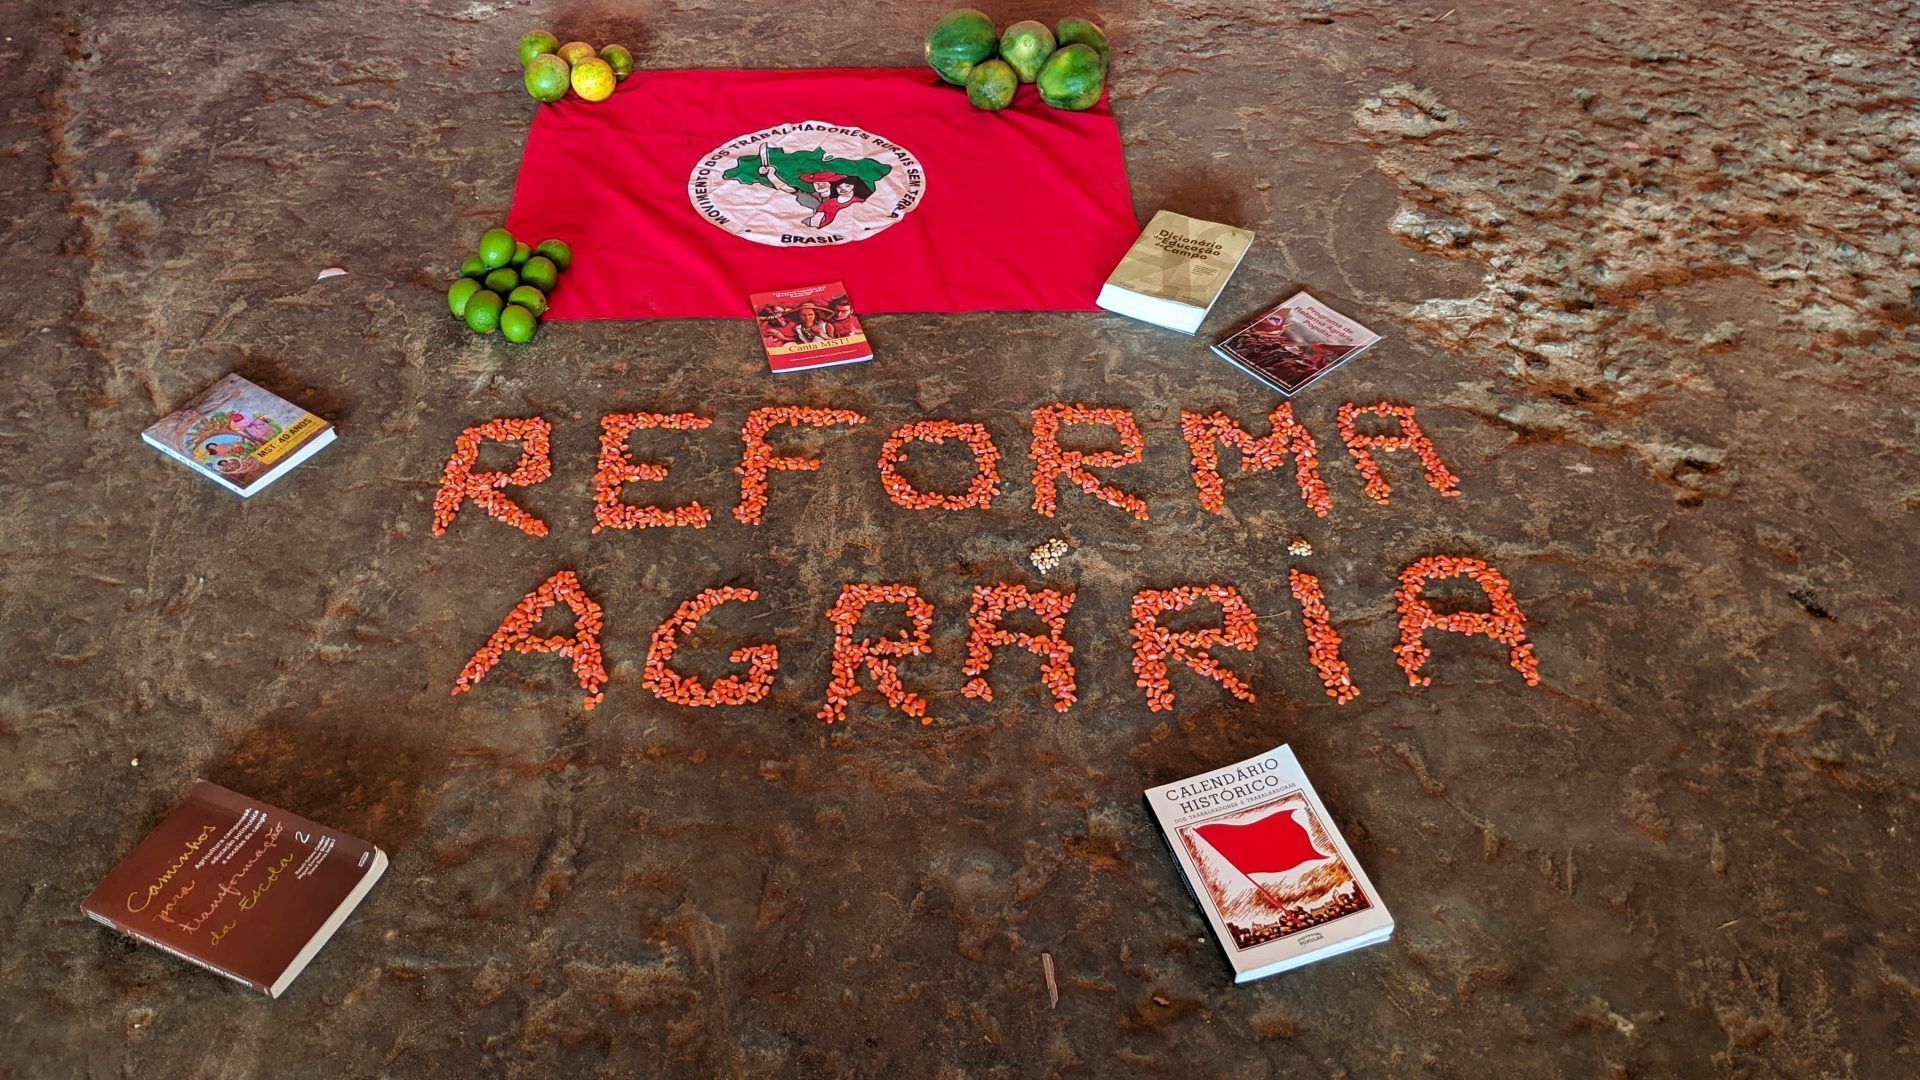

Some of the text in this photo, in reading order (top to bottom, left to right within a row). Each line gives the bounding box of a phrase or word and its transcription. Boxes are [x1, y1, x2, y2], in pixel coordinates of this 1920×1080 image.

[729, 124, 870, 149] TRABALHADORES
[705, 149, 730, 167] DOS
[872, 138, 914, 166] RURAIS
[907, 169, 920, 186] SEM
[695, 168, 730, 224] MOVIMENTO
[781, 233, 844, 244] BRASIL
[1159, 229, 1223, 250] Dicionário
[1161, 238, 1220, 256] Educação
[1163, 245, 1207, 260] Campo
[1295, 306, 1326, 327] Reforma
[1303, 319, 1332, 338] Popular
[1307, 306, 1343, 329] Programa
[788, 344, 818, 353] Canta
[278, 433, 291, 444] 40
[289, 418, 313, 435] ANOS
[432, 401, 1460, 537] REFORMA
[1165, 758, 1278, 801] CALENDÁRIO
[1174, 816, 1187, 824] DOS
[1189, 802, 1239, 820] TRABALHADORES
[1246, 782, 1296, 803] TRABALHADORAS
[1179, 775, 1279, 814] HISTÓRICO
[211, 810, 260, 865] educação politécnica
[226, 840, 247, 860] escolas
[252, 813, 267, 833] campo
[295, 831, 311, 844] 2
[195, 839, 225, 869] Agricultura
[127, 825, 216, 913] Caminhos
[179, 821, 283, 934] transformação
[152, 880, 195, 923] para
[210, 853, 293, 946] da Escola
